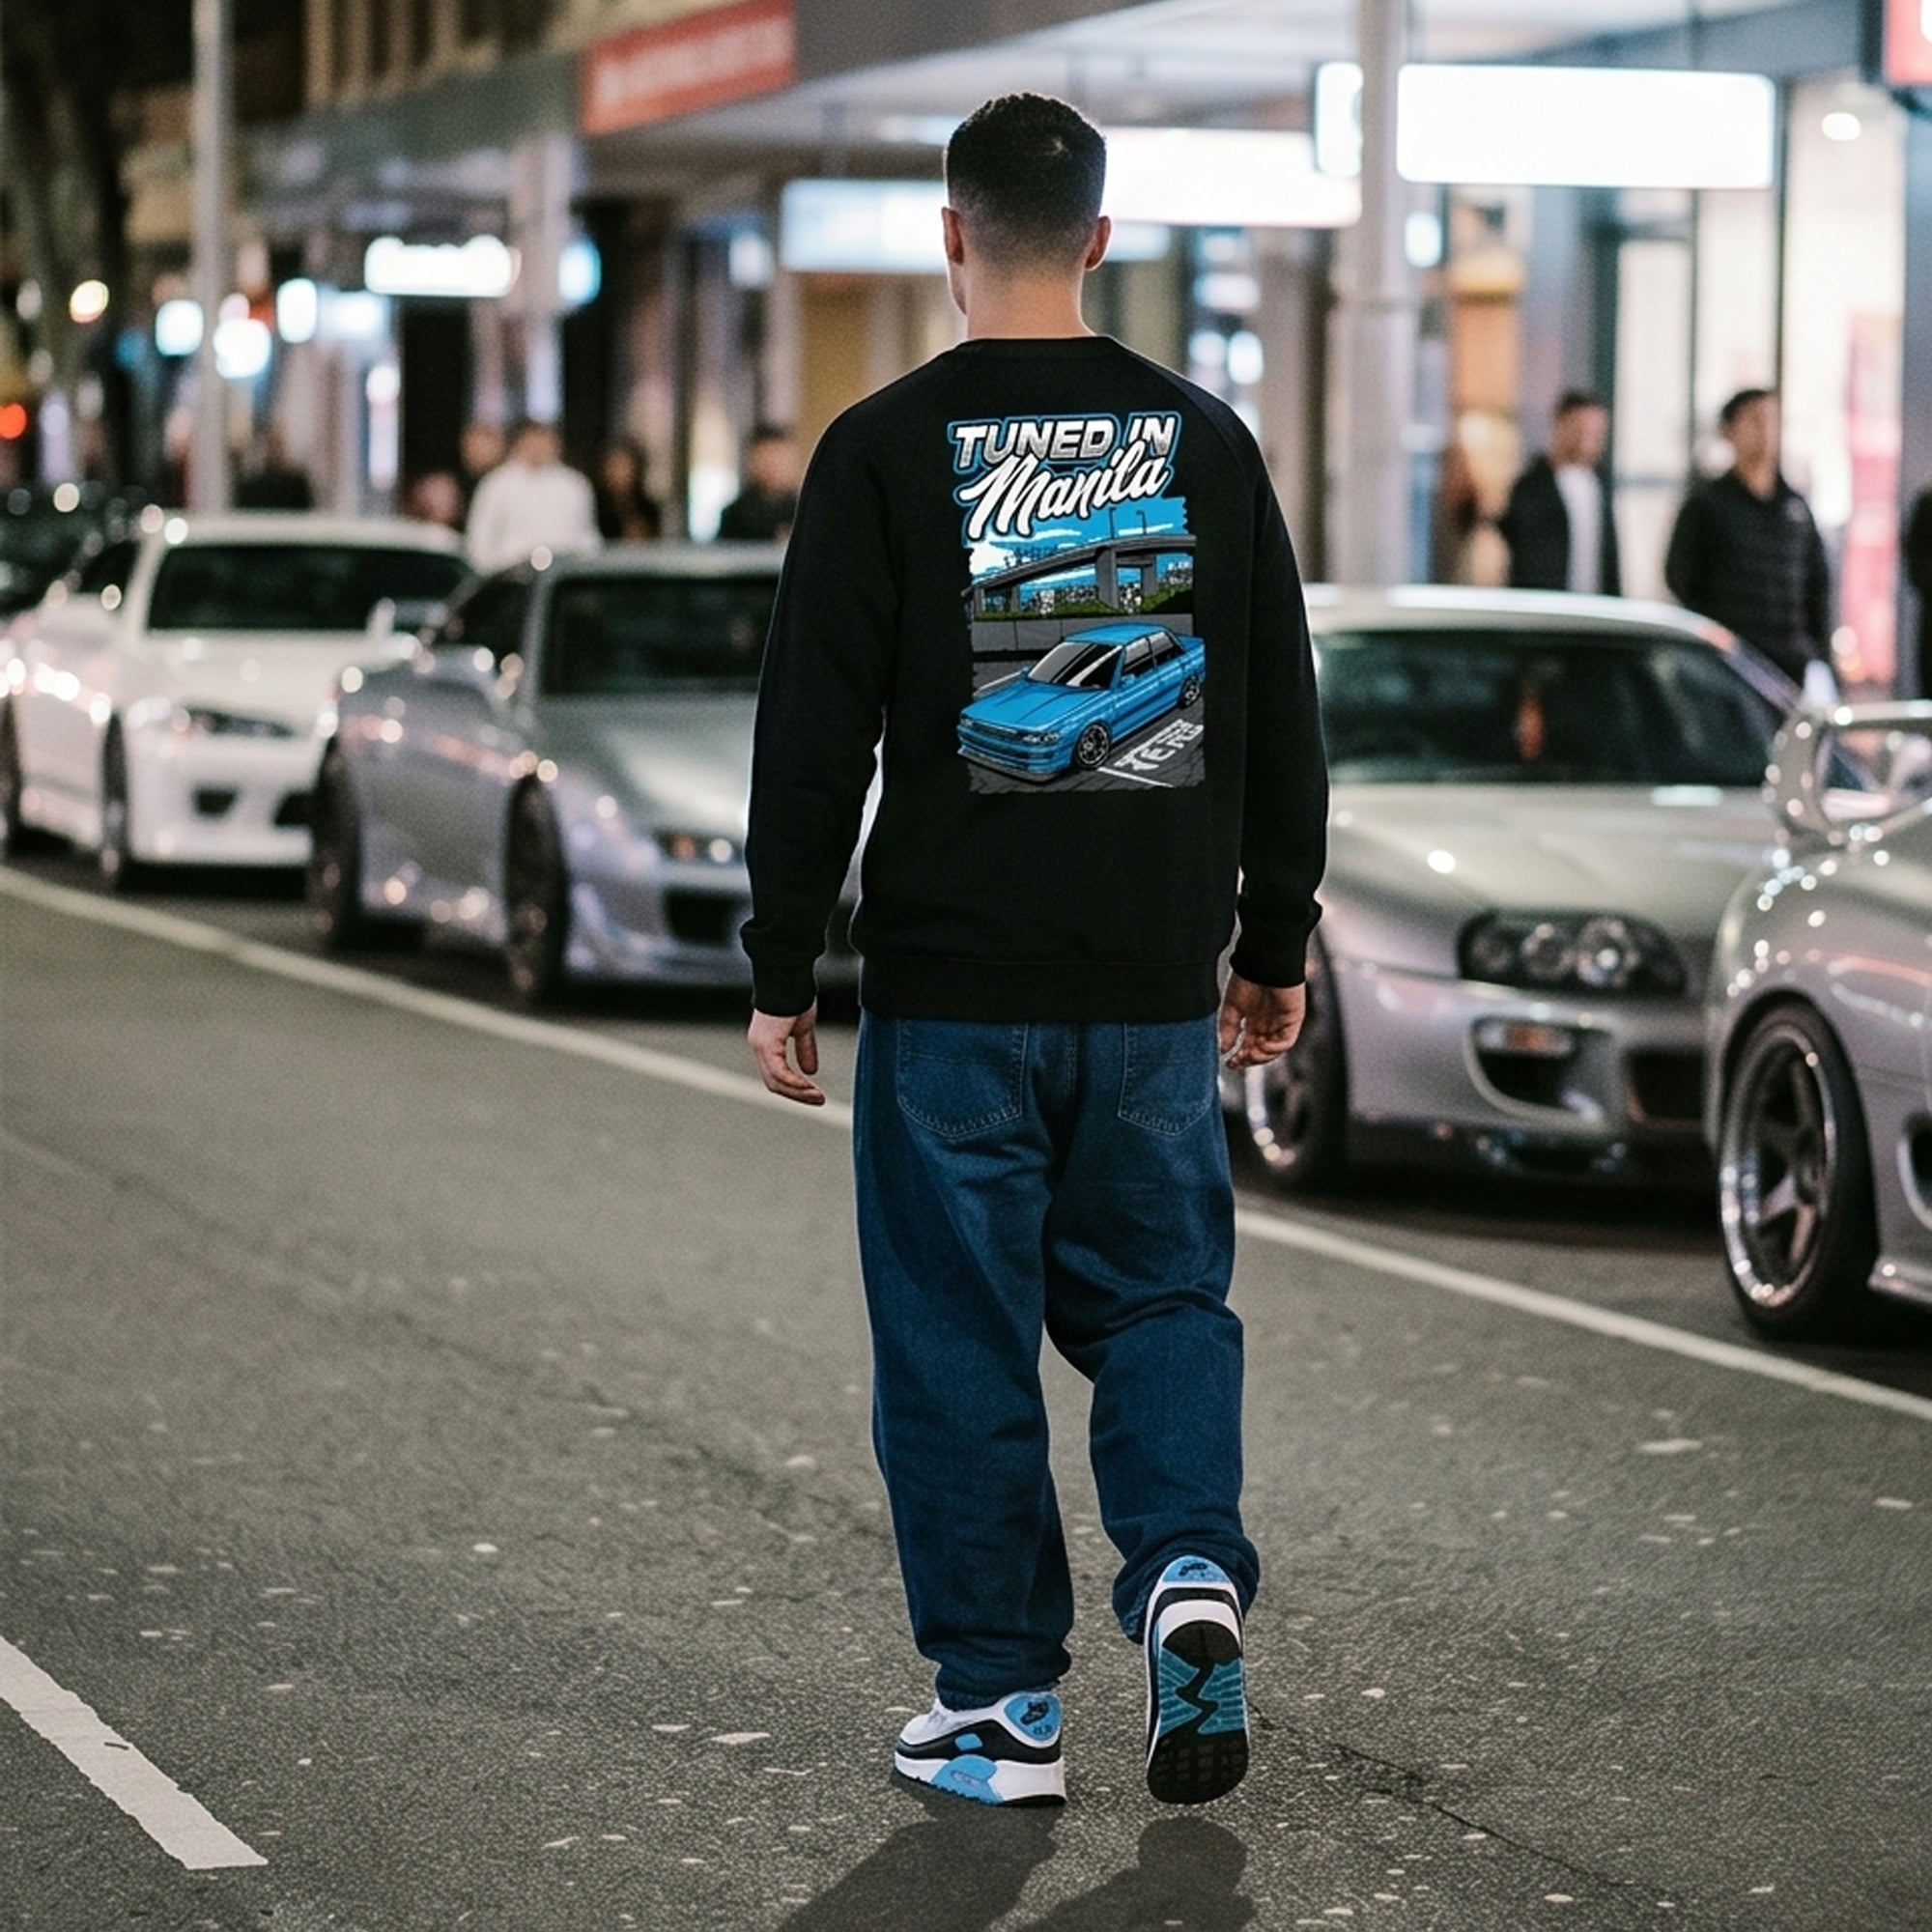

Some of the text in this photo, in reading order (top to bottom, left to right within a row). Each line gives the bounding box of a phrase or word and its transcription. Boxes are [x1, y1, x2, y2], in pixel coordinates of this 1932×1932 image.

[954, 415, 1176, 469] TUNED IN
[958, 440, 1170, 539] Manila
